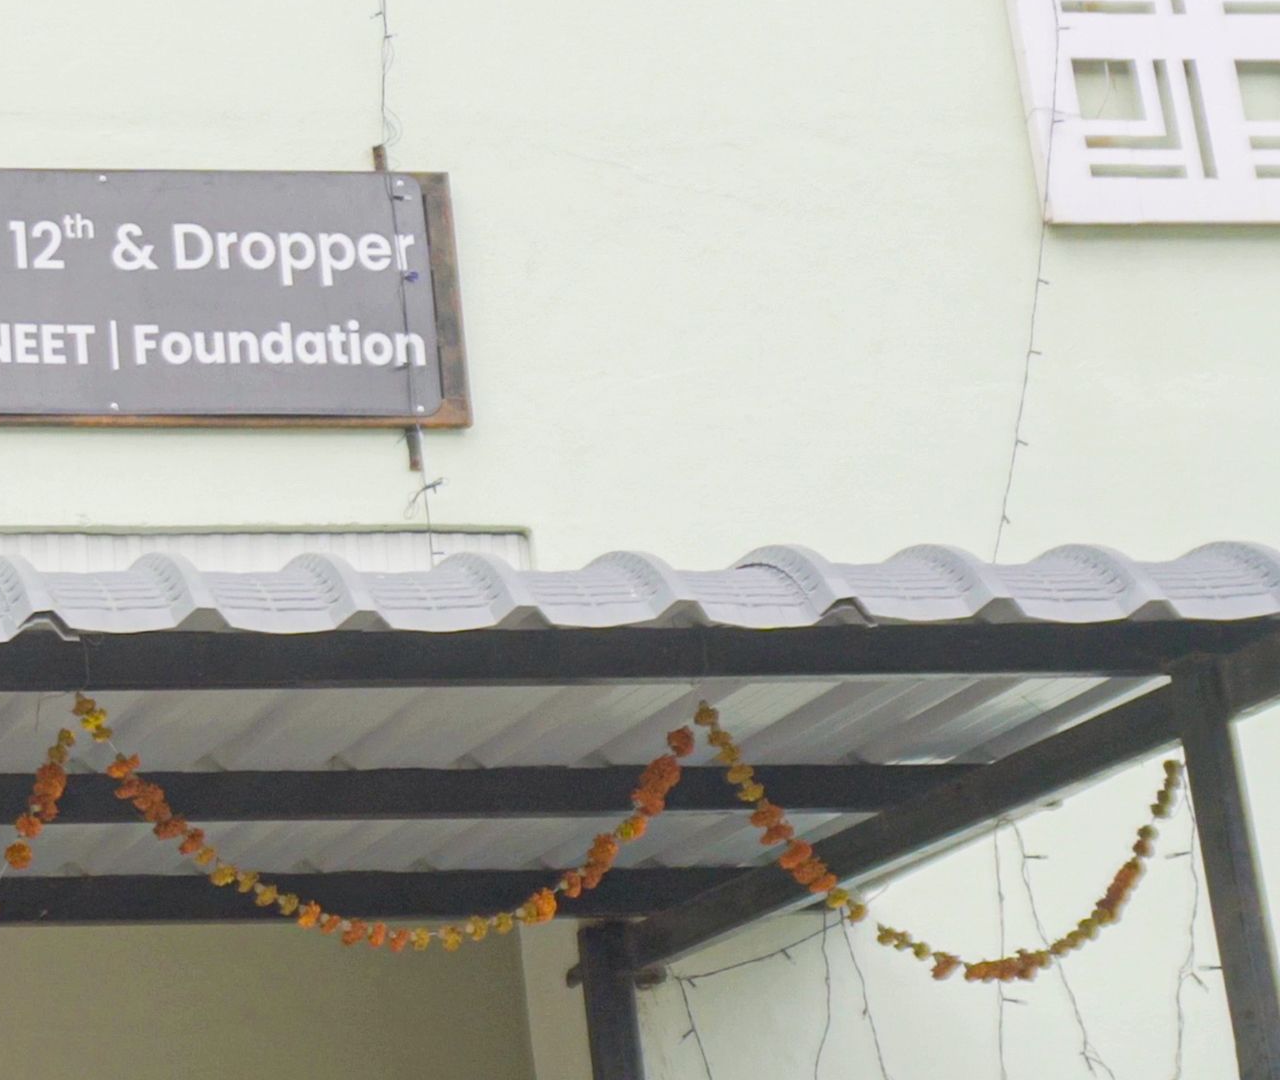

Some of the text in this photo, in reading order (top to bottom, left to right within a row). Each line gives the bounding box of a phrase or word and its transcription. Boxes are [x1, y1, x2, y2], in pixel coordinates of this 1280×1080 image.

[10, 213, 94, 269] 12th
[111, 223, 157, 270] &
[174, 222, 416, 286] Dropper
[135, 320, 426, 366] Foundation
